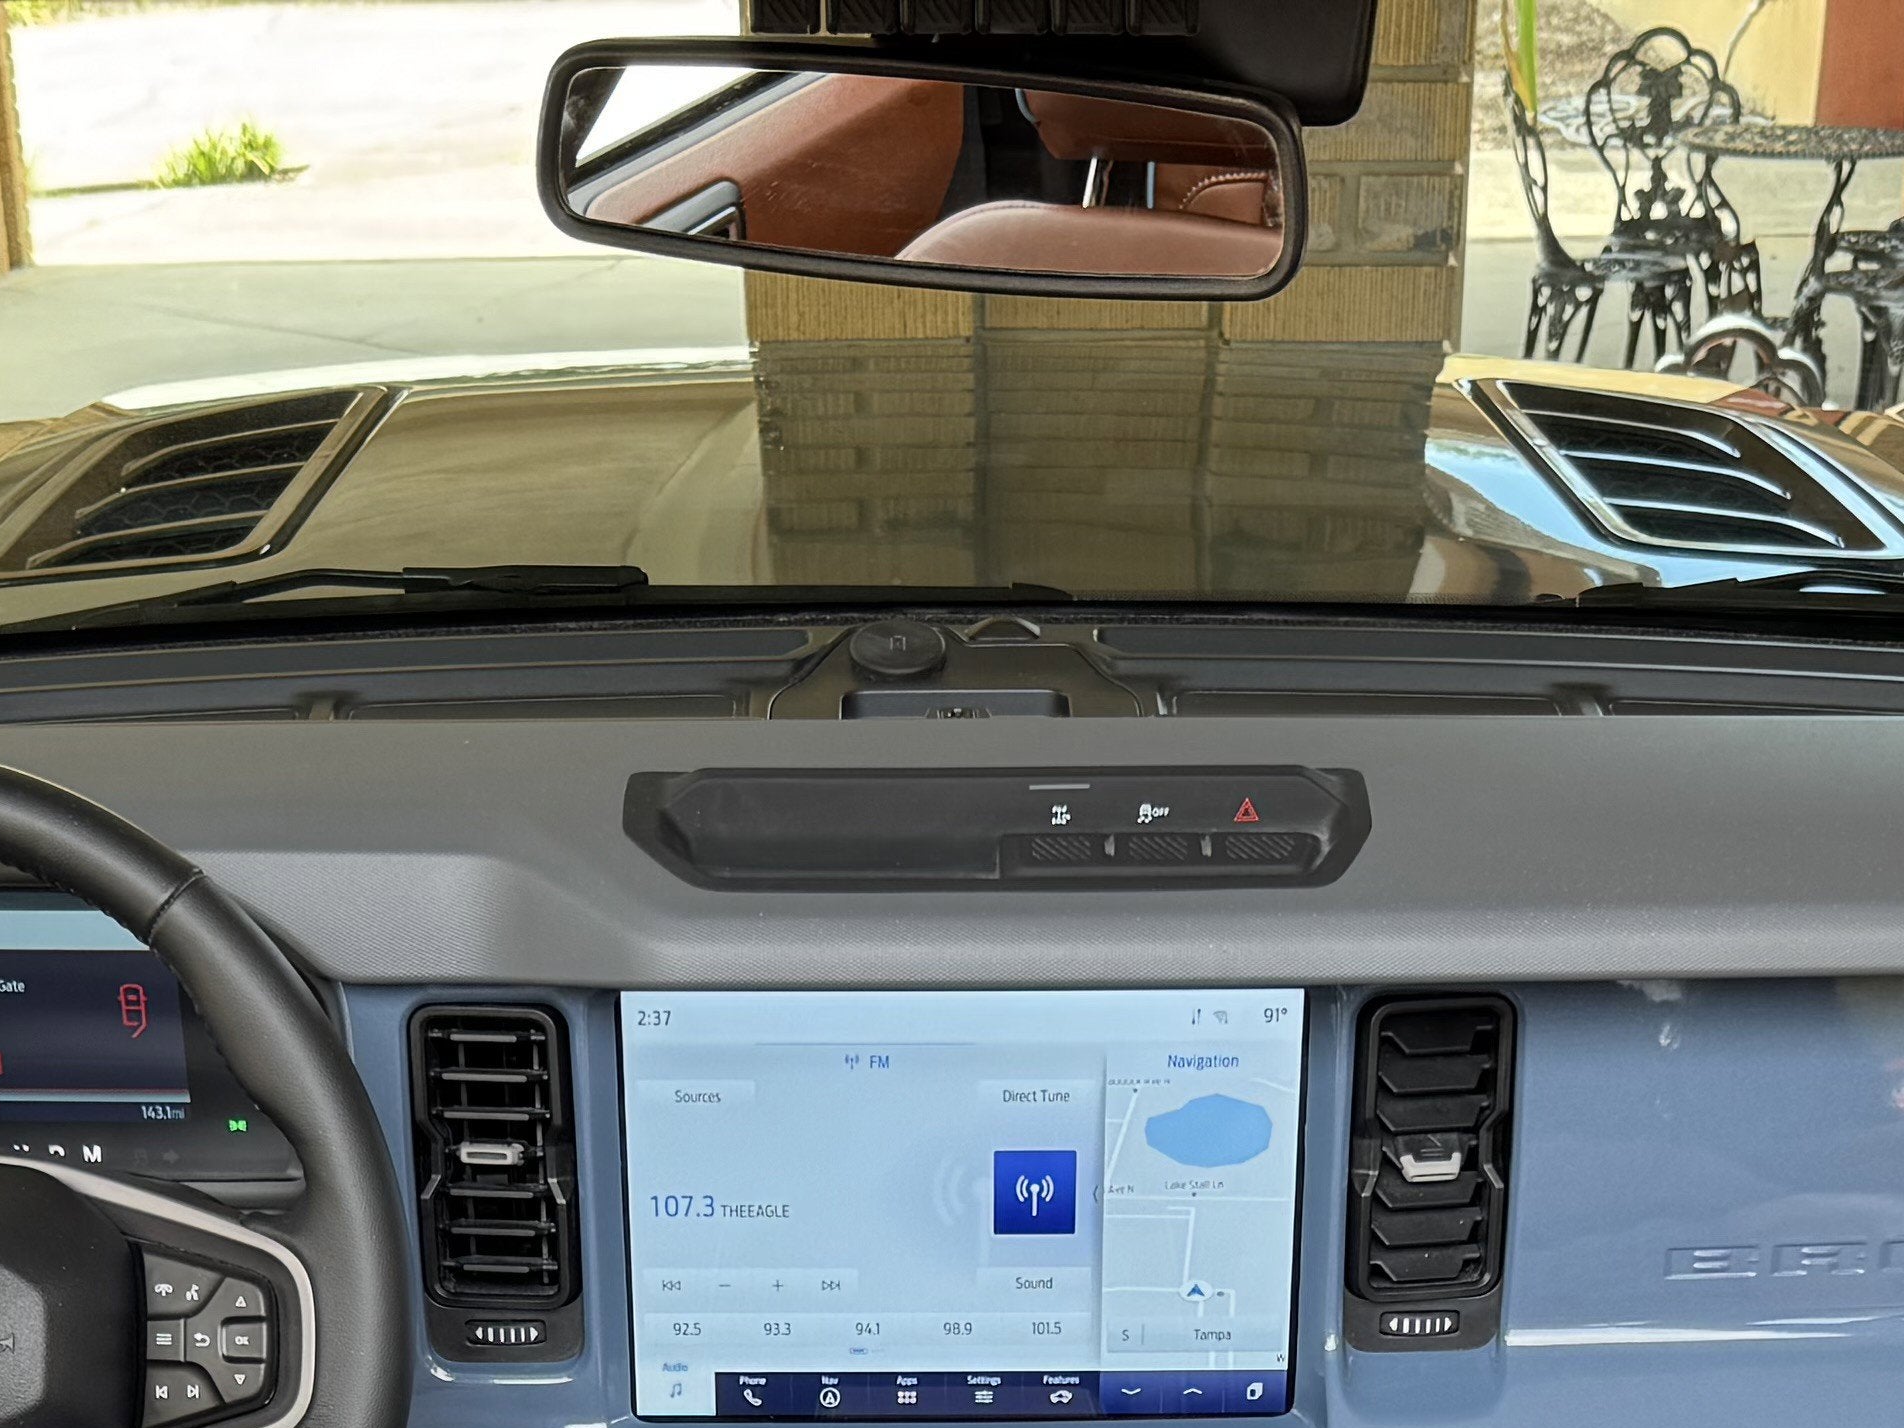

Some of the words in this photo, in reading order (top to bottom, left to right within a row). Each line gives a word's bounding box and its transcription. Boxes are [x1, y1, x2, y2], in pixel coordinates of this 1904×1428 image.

[637, 1010, 672, 1027] 2:37
[869, 1055, 890, 1069] FM
[1167, 1054, 1240, 1071] Navigation
[674, 1089, 722, 1104] Sources
[1002, 1088, 1036, 1103] Direct
[1040, 1089, 1070, 1103] Tune
[650, 1195, 715, 1218] 107.3
[720, 1204, 790, 1218] THEEAGLE
[1015, 1276, 1054, 1290] Sound
[672, 1322, 702, 1336] 92.5
[763, 1322, 792, 1336] 93.3
[855, 1322, 881, 1336] 94.1
[943, 1322, 973, 1336] 98.9
[1031, 1321, 1062, 1335] 101.5
[234, 1335, 250, 1346] OK
[1122, 1329, 1130, 1342] S
[1193, 1329, 1232, 1342] Tampa
[662, 1362, 688, 1373] Audio
[739, 1375, 767, 1386] Phone
[821, 1375, 840, 1386] Nav
[896, 1375, 918, 1387] Apps
[966, 1374, 1002, 1387] Settings
[1042, 1374, 1080, 1386] Features
